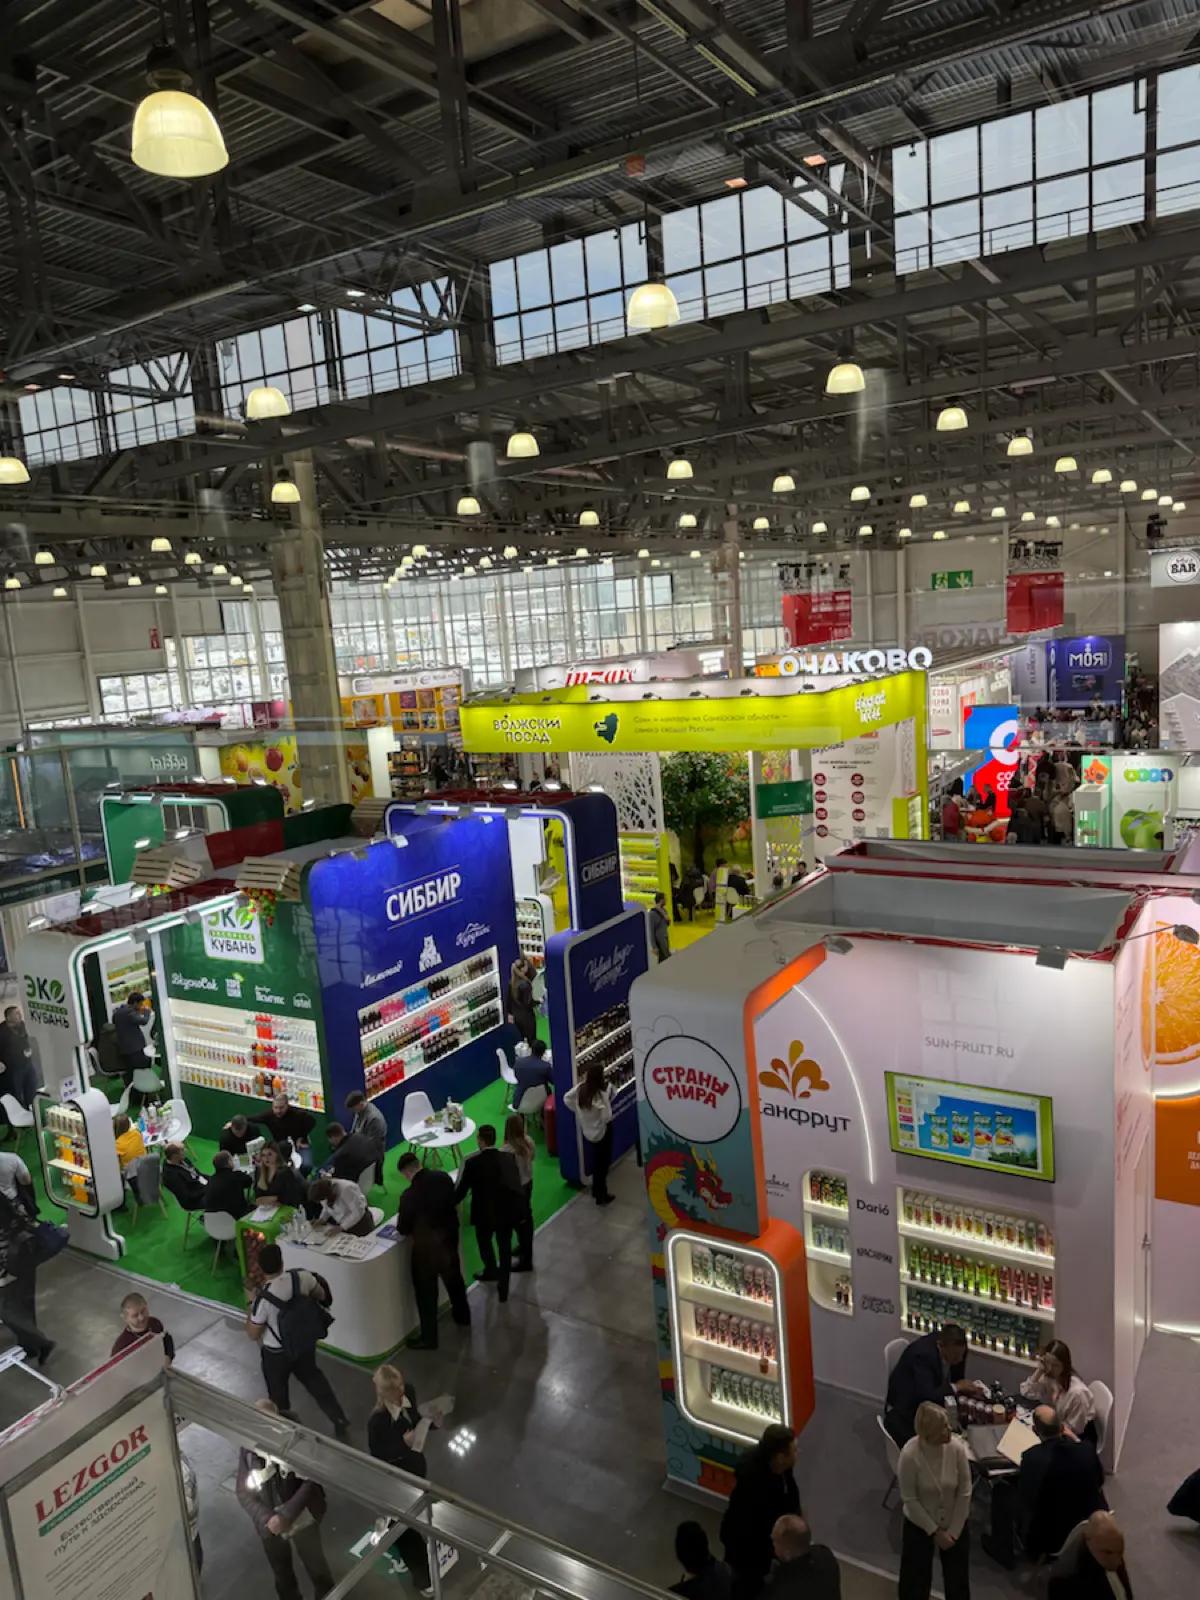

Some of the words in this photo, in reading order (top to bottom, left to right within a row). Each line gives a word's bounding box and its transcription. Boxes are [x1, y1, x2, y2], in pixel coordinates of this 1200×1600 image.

[1171, 563, 1196, 574] BAR
[779, 646, 932, 676] ОЧАКОВО
[494, 715, 561, 731] ВОЛЖСКИЙ
[506, 731, 551, 744] ПОСАД
[386, 872, 461, 921] СИББИР
[211, 938, 257, 956] КУБАНЬ
[24, 974, 65, 1004] ЭКО
[30, 1010, 70, 1028] КУБАНЬ
[925, 1036, 1014, 1058] SUN-FRUIT.RU
[652, 1066, 729, 1096] СТРАНЫ
[665, 1084, 717, 1109] МИРА
[759, 1098, 851, 1133] анфрут
[856, 1199, 890, 1216] Darió
[34, 1424, 149, 1524] LEZGOR
[54, 1534, 80, 1556] путь
[90, 1481, 147, 1528] здоровью
[60, 1476, 139, 1542] Естественный
